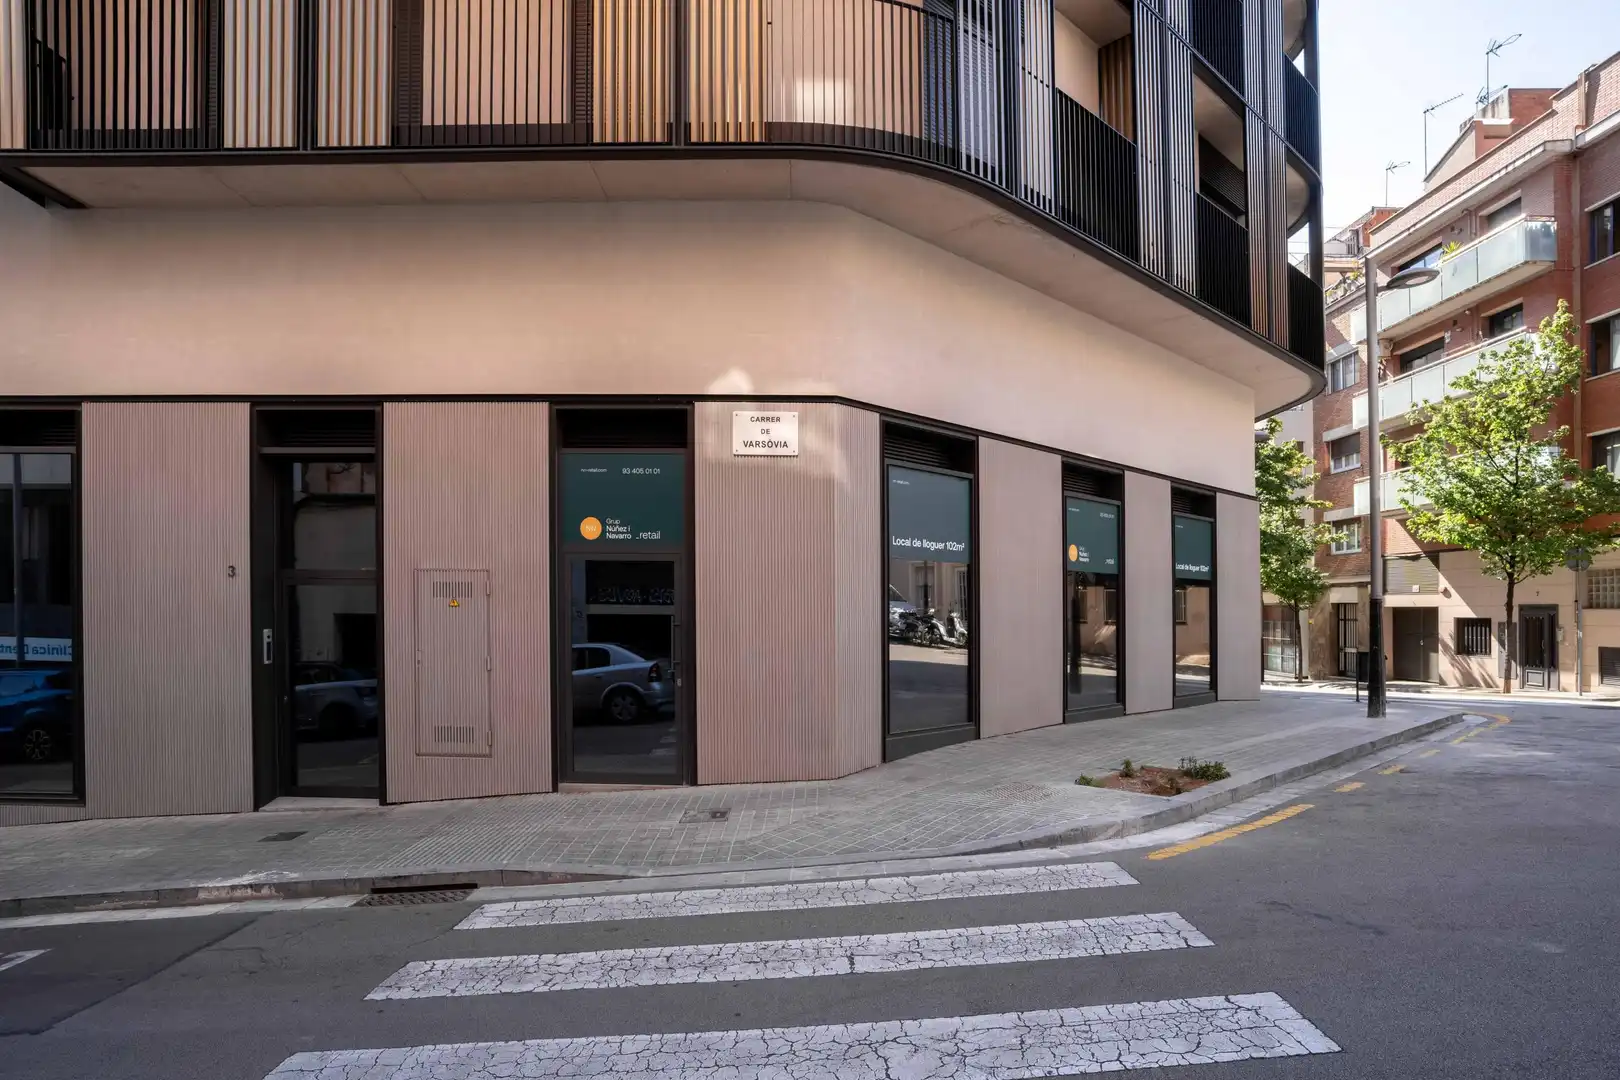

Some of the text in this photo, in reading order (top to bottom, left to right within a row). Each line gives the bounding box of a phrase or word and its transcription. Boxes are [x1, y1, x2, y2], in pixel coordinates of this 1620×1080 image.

[892, 536, 911, 547] Local
[912, 538, 922, 547] de
[923, 538, 945, 551] lloguer
[228, 565, 236, 578] 3
